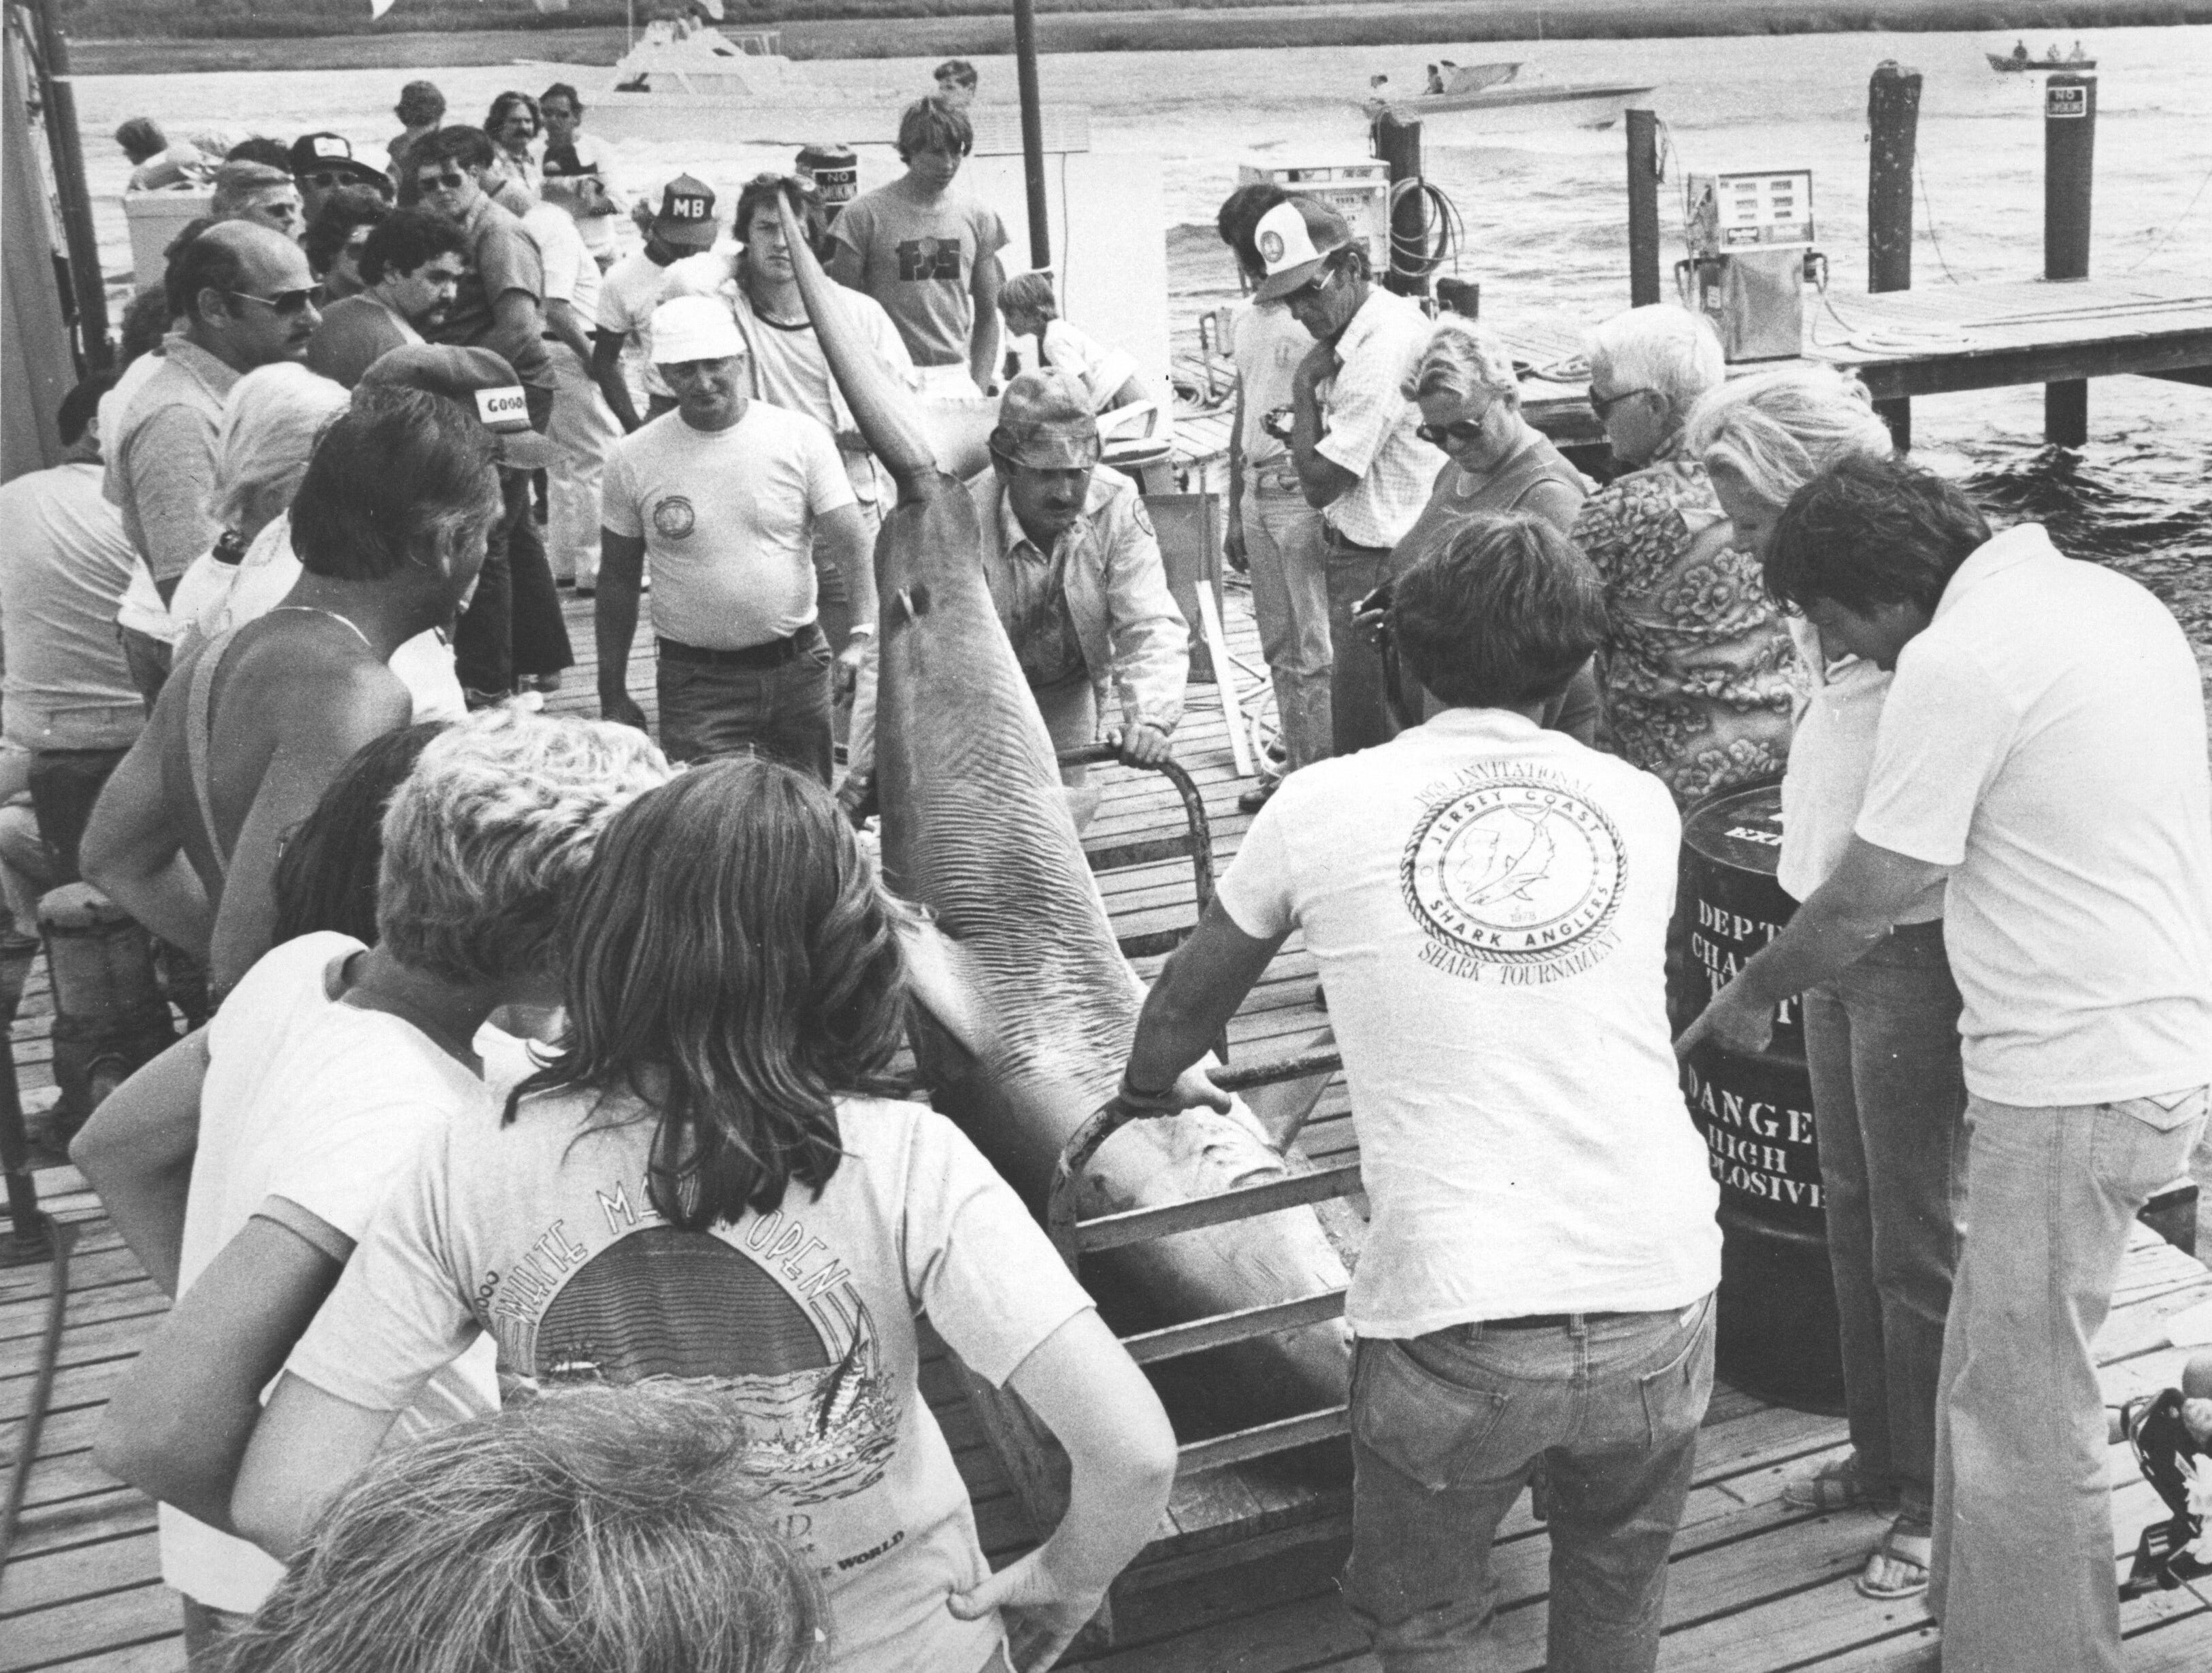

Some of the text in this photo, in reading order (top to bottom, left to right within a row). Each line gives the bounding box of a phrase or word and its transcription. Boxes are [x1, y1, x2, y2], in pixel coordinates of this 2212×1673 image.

[827, 171, 849, 182] NO
[673, 197, 705, 218] MB
[1430, 790, 1601, 845] JERSEY COAST
[1430, 885, 1608, 947] SHARK ANGLERS
[1417, 925, 1622, 986] SHARK TOURNAMENT
[1688, 1063, 1813, 1144] DANGE
[1708, 1123, 1788, 1174] HIGH
[495, 1219, 589, 1326] WHITE
[746, 1210, 851, 1302] OPEN
[837, 1531, 905, 1571] WORLD
